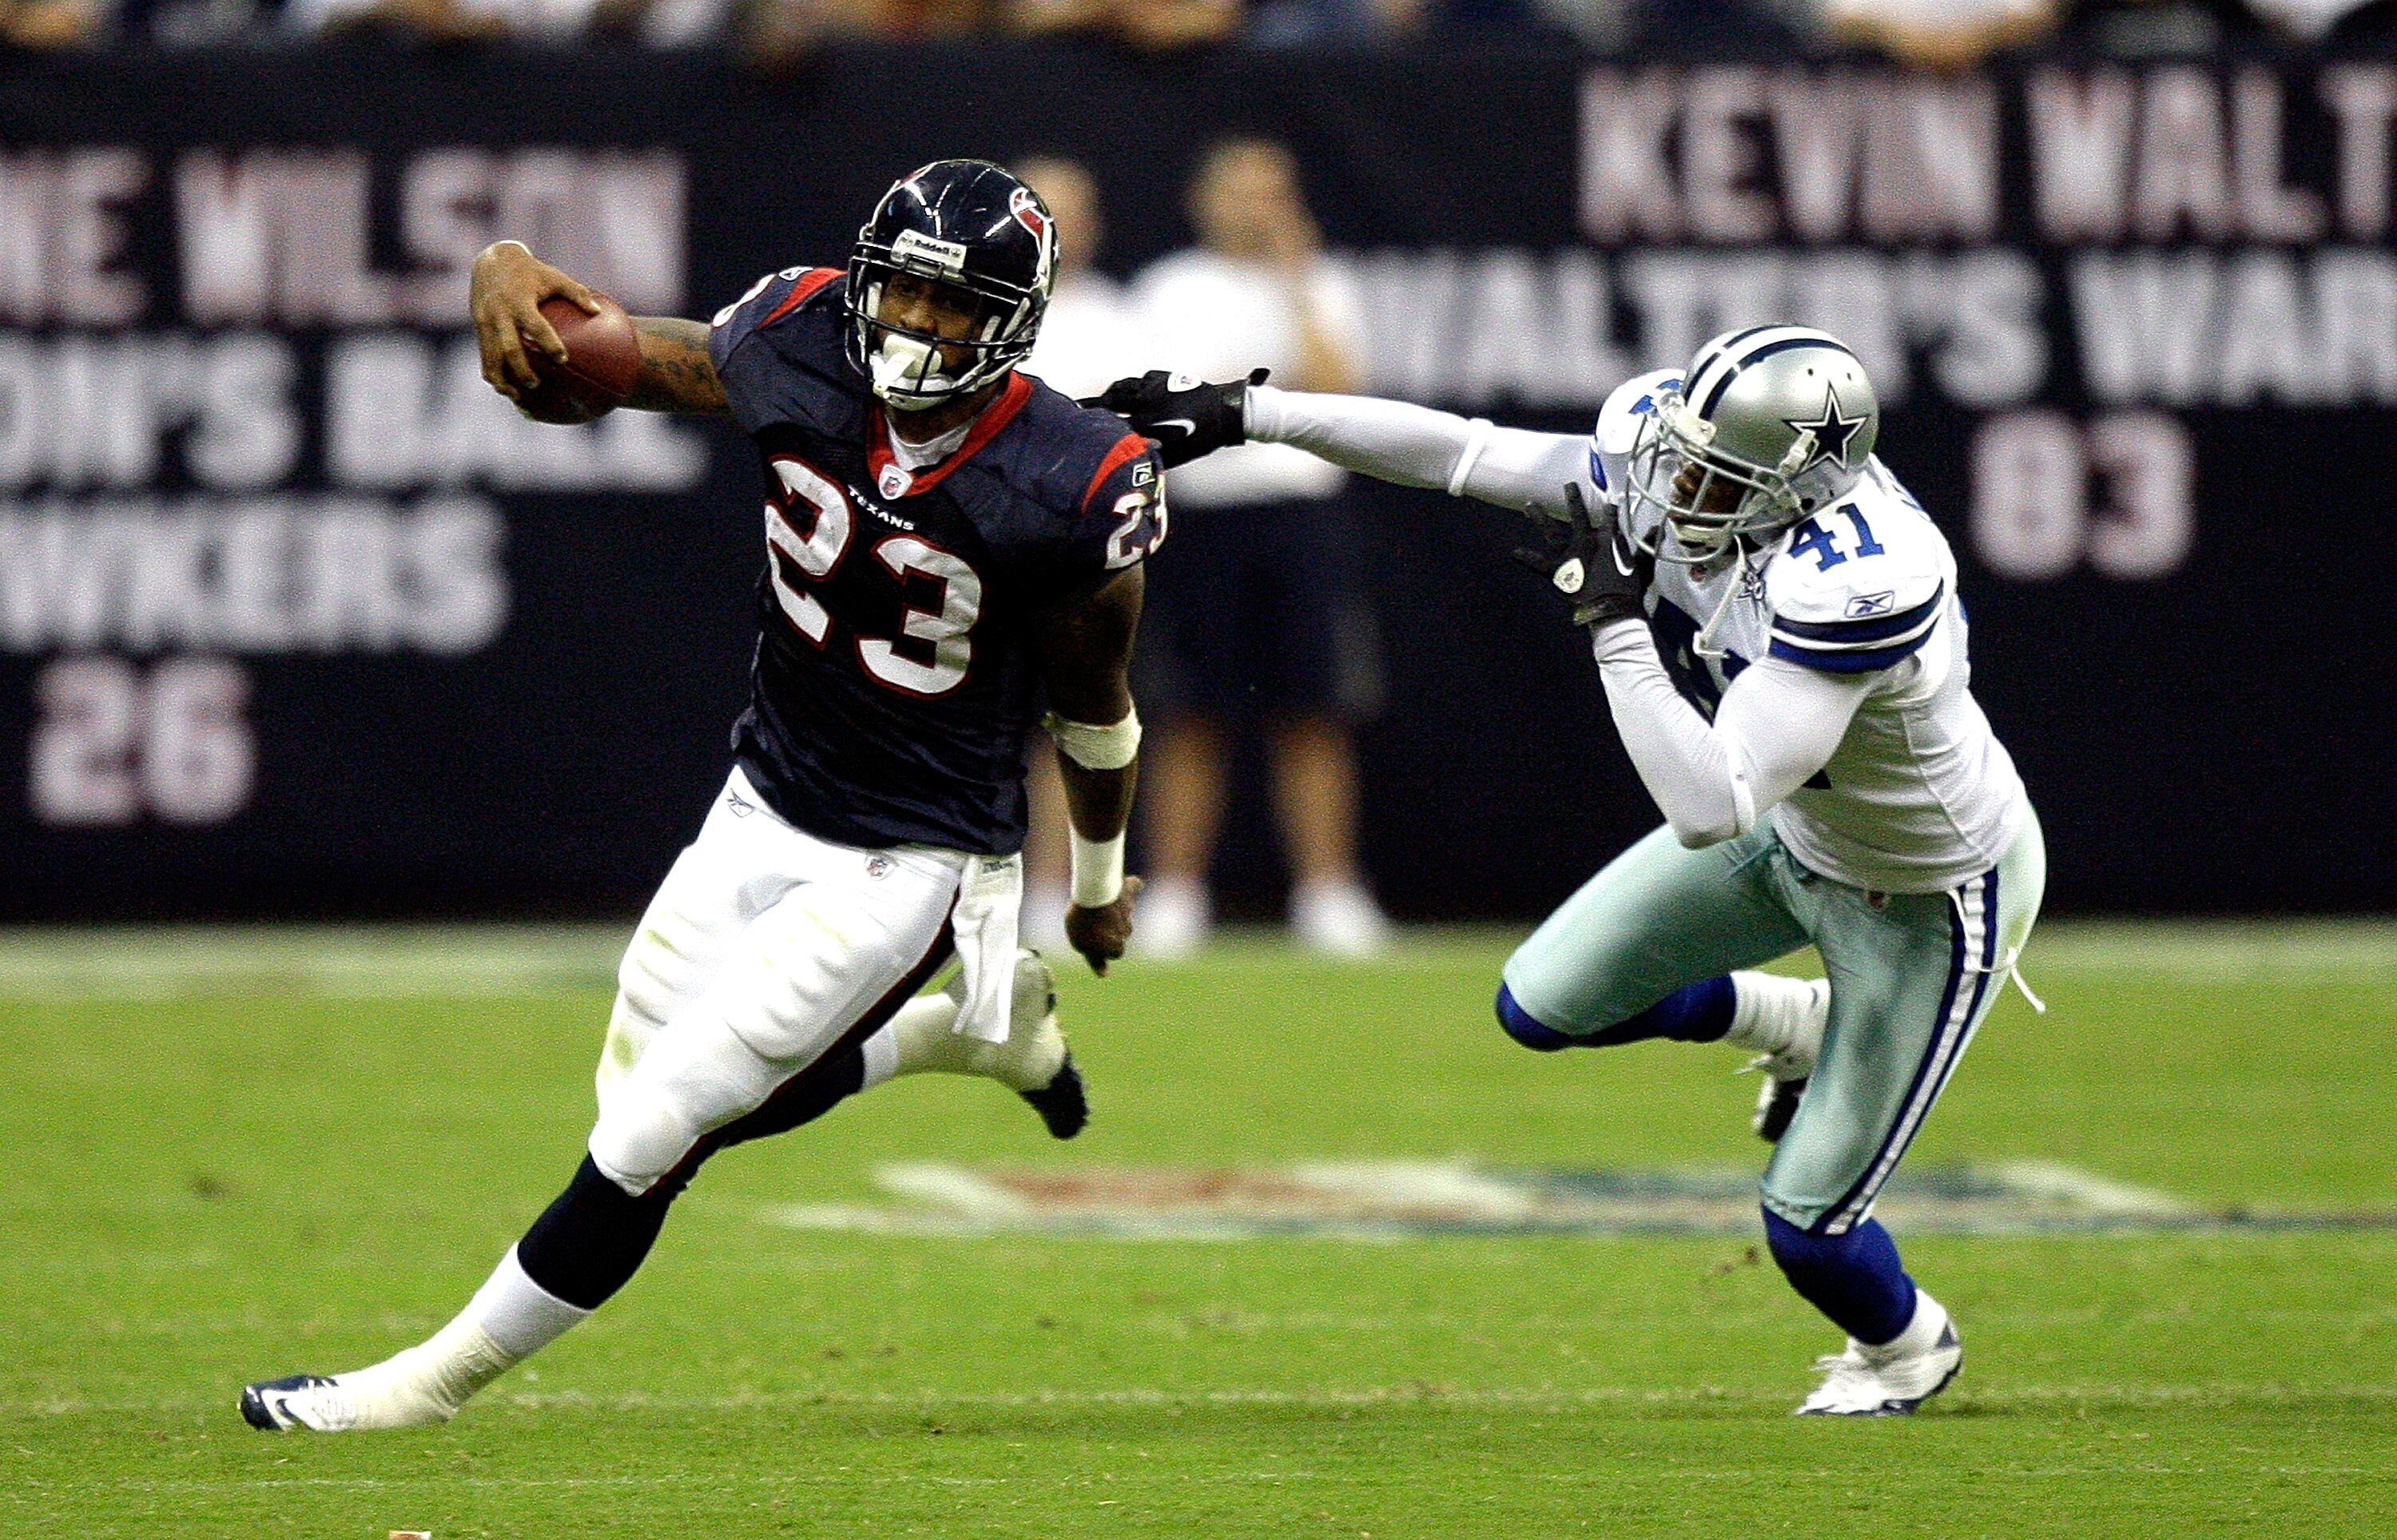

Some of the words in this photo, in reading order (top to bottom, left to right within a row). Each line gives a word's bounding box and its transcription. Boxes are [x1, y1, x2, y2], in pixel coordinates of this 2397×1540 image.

[1576, 69, 1999, 240] KEVIN
[762, 455, 984, 697] 23
[848, 484, 914, 530] TEXANS
[1787, 502, 1886, 574] 41
[1969, 411, 2196, 578] 83
[29, 658, 254, 820] 26
